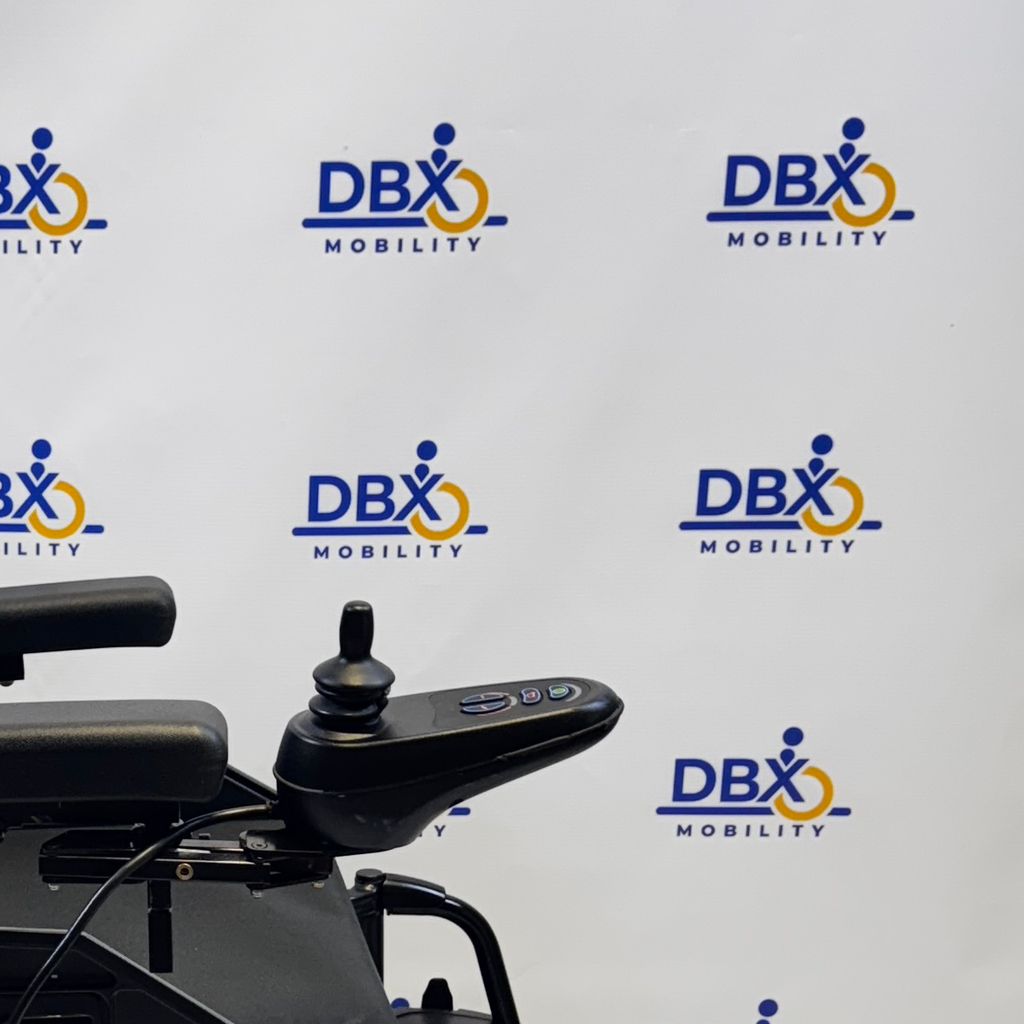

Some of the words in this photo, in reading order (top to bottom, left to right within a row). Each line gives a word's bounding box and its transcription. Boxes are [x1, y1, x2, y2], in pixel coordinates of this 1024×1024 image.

[317, 158, 463, 213] DBX
[723, 153, 872, 208] DBX
[324, 237, 483, 254] MOBILITY
[727, 230, 888, 247] MOBILITY
[307, 473, 445, 522] DBX
[696, 467, 840, 517] DBX
[313, 544, 463, 559] MOBILITY
[700, 539, 856, 554] MOBILITY
[672, 758, 810, 803] DBX
[676, 824, 825, 837] MOBILITY
